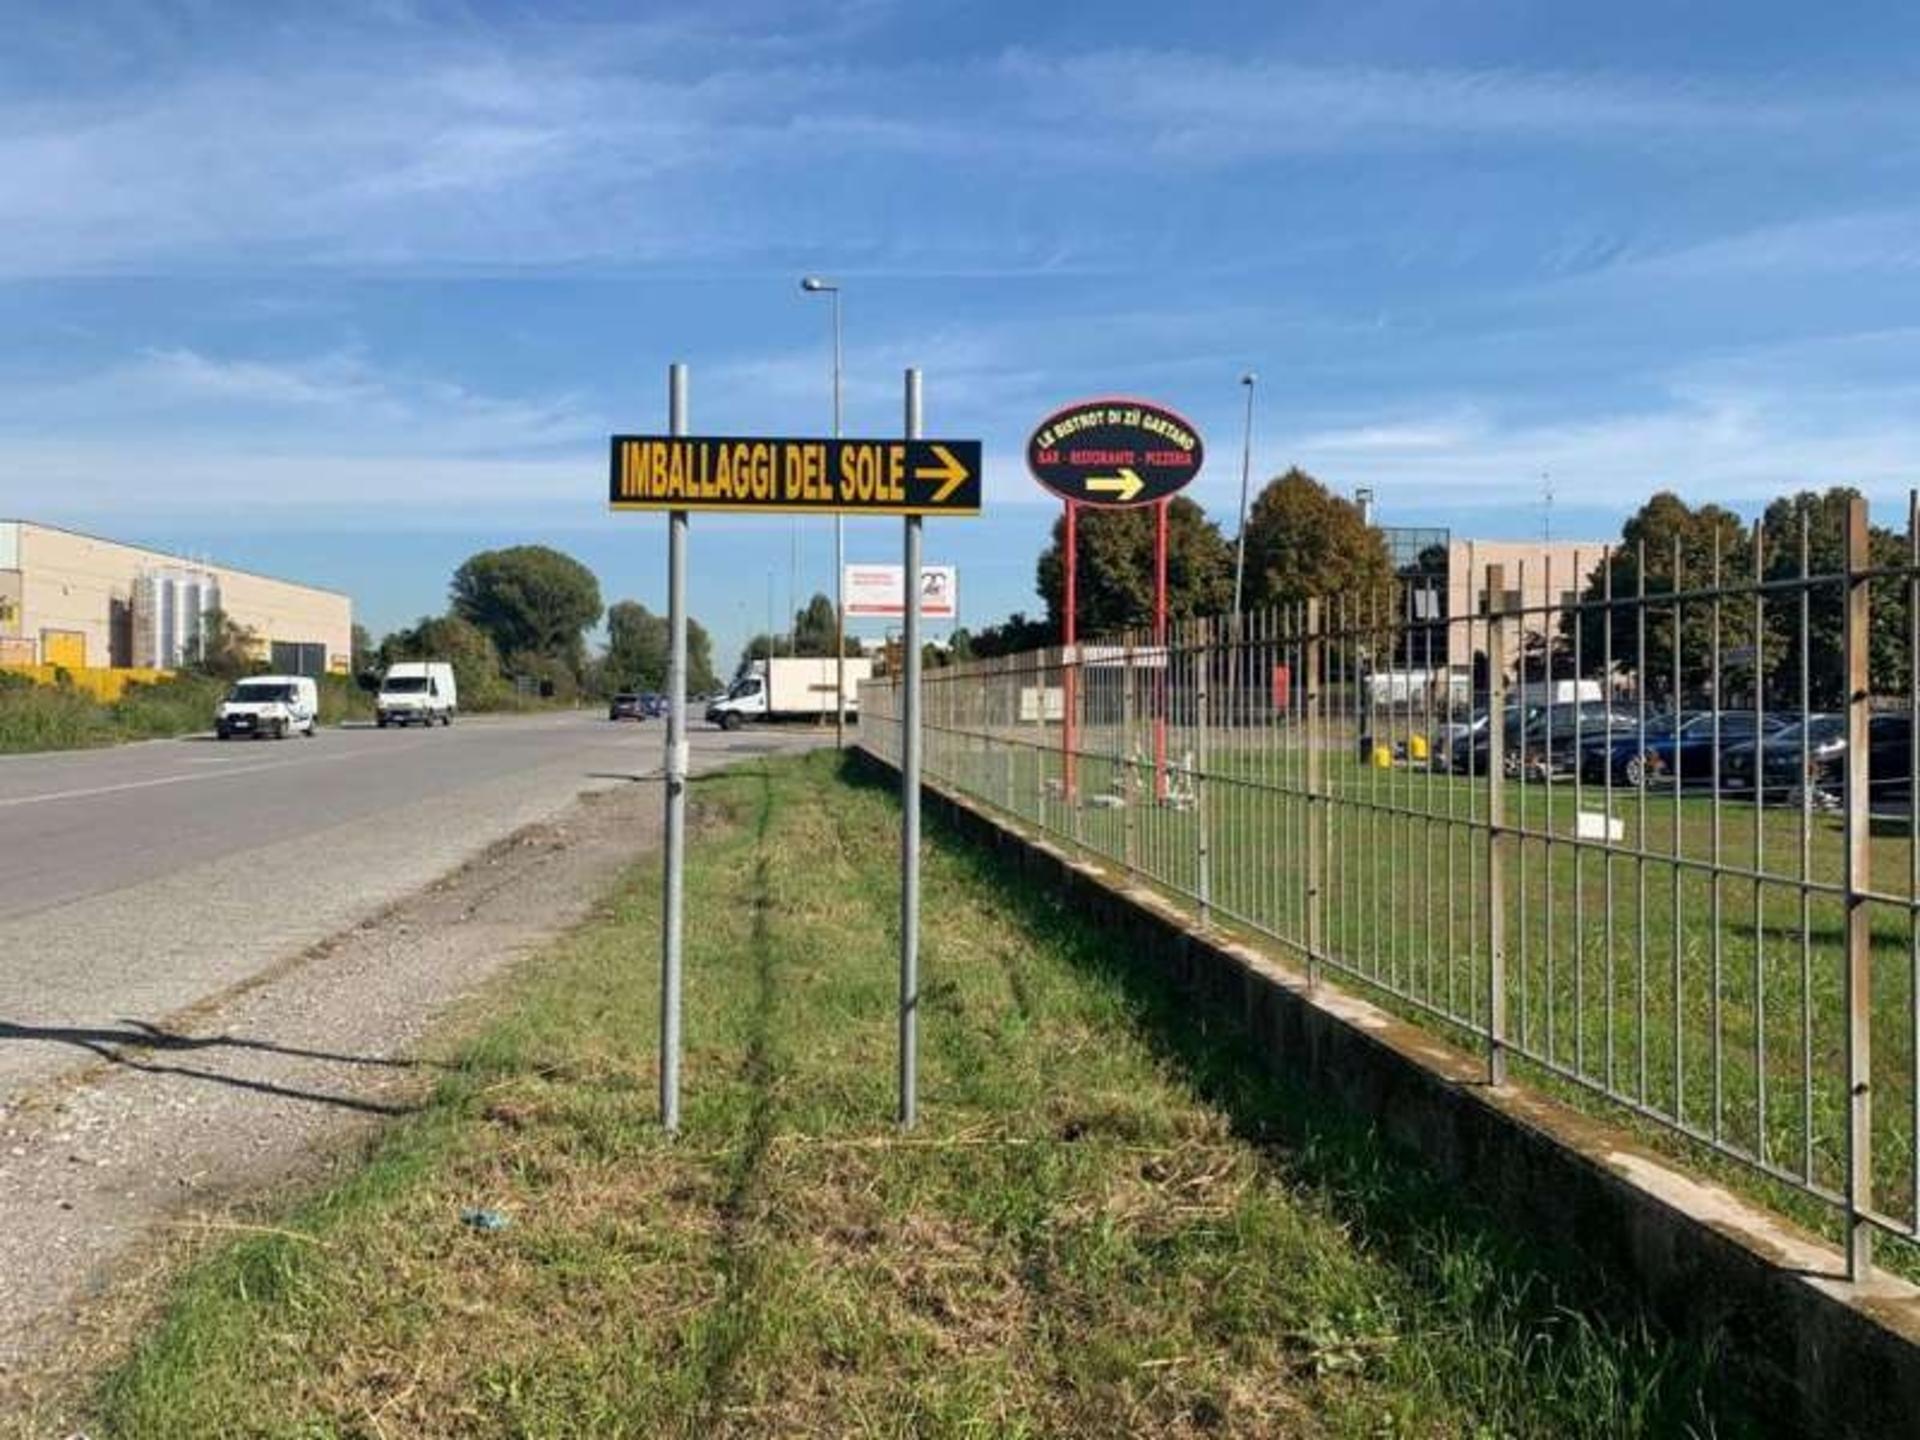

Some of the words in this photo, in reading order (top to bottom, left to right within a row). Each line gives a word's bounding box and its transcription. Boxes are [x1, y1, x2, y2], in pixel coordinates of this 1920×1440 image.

[620, 441, 777, 499] IMBALLAGGI
[785, 444, 833, 500] DEL
[839, 445, 905, 501] SOLE
